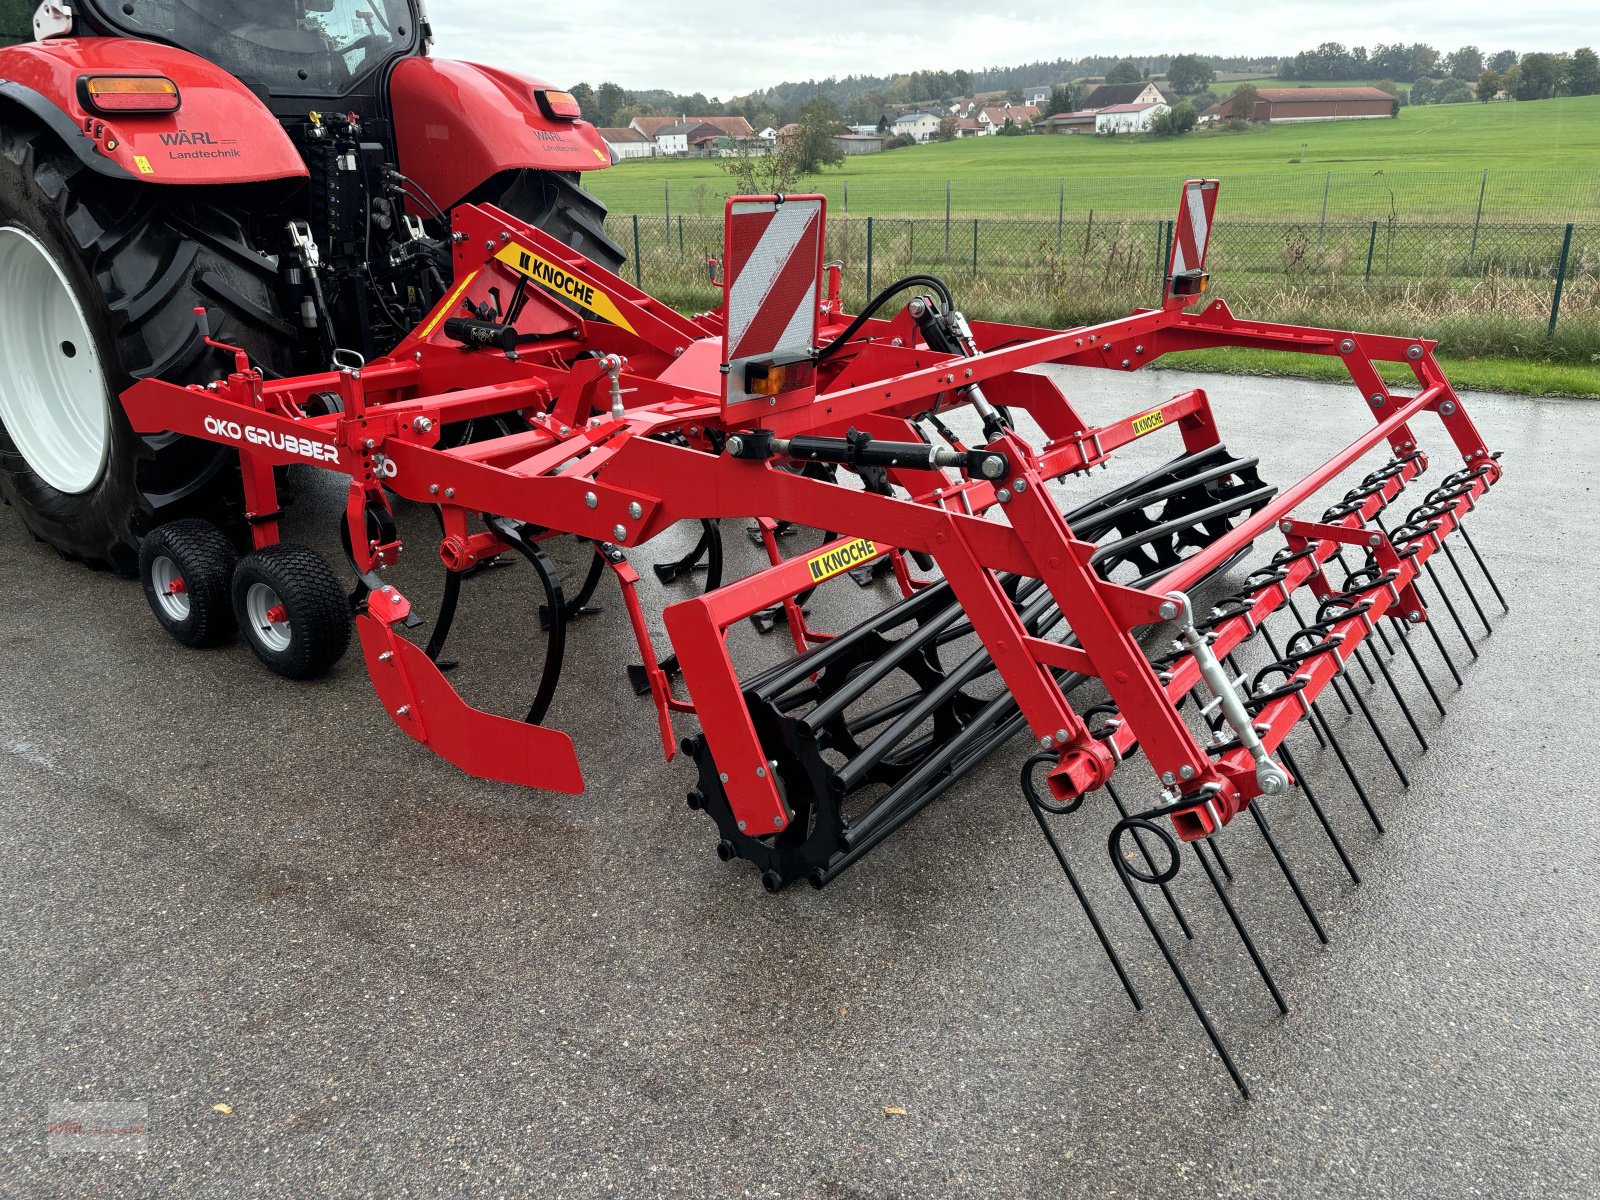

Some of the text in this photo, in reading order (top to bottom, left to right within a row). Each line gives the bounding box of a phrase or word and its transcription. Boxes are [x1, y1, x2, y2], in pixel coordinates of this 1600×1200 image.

[159, 130, 218, 146] WÄRL
[533, 129, 565, 141] WÄRL
[168, 149, 240, 160] Landtechnik
[532, 258, 595, 306] KNOCHE
[1139, 411, 1164, 431] KNOCHE
[204, 414, 242, 440] ÖKO
[245, 425, 340, 465] GRUBBER
[821, 540, 875, 574] KNOCHE
